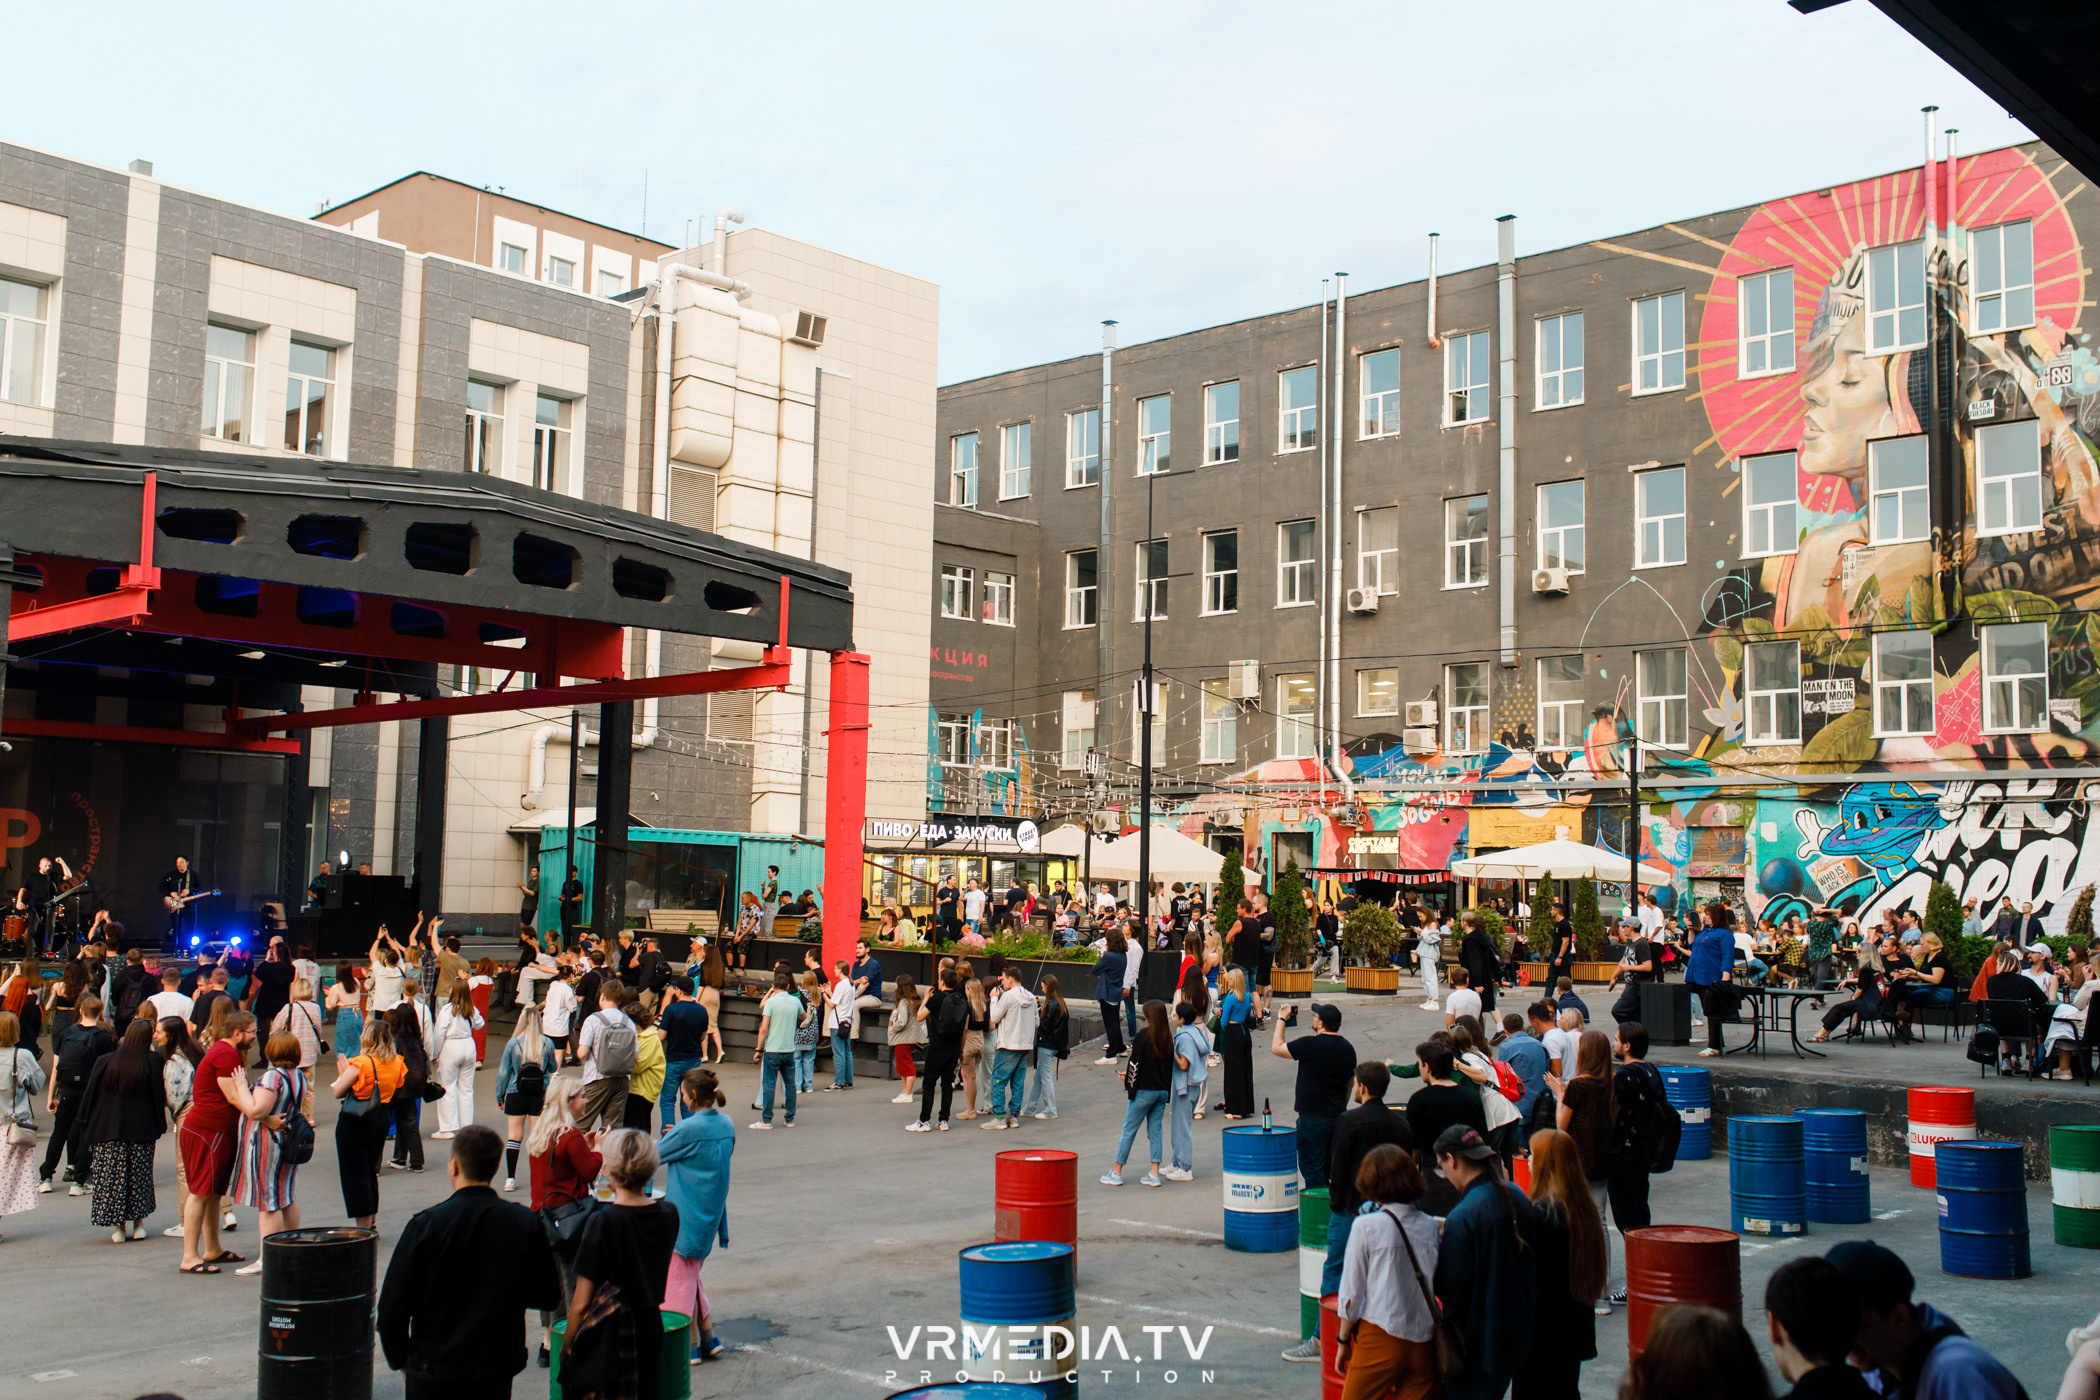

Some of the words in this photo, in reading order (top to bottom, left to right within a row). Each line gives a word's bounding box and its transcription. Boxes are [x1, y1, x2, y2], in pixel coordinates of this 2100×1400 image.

[1971, 401, 1991, 410] BLACK
[1804, 682, 1822, 691] MAN
[1825, 681, 1836, 690] ON
[1839, 680, 1853, 690] THE
[1829, 691, 1853, 700] MOON
[873, 822, 913, 837] ПИВО
[919, 824, 947, 841] ЕДА
[954, 826, 1012, 841] ЗАКУСКИ
[1019, 828, 1036, 839] STREET
[1022, 834, 1034, 842] FOOD
[1348, 837, 1399, 846] COCKTAILS
[1818, 870, 1836, 886] WHO
